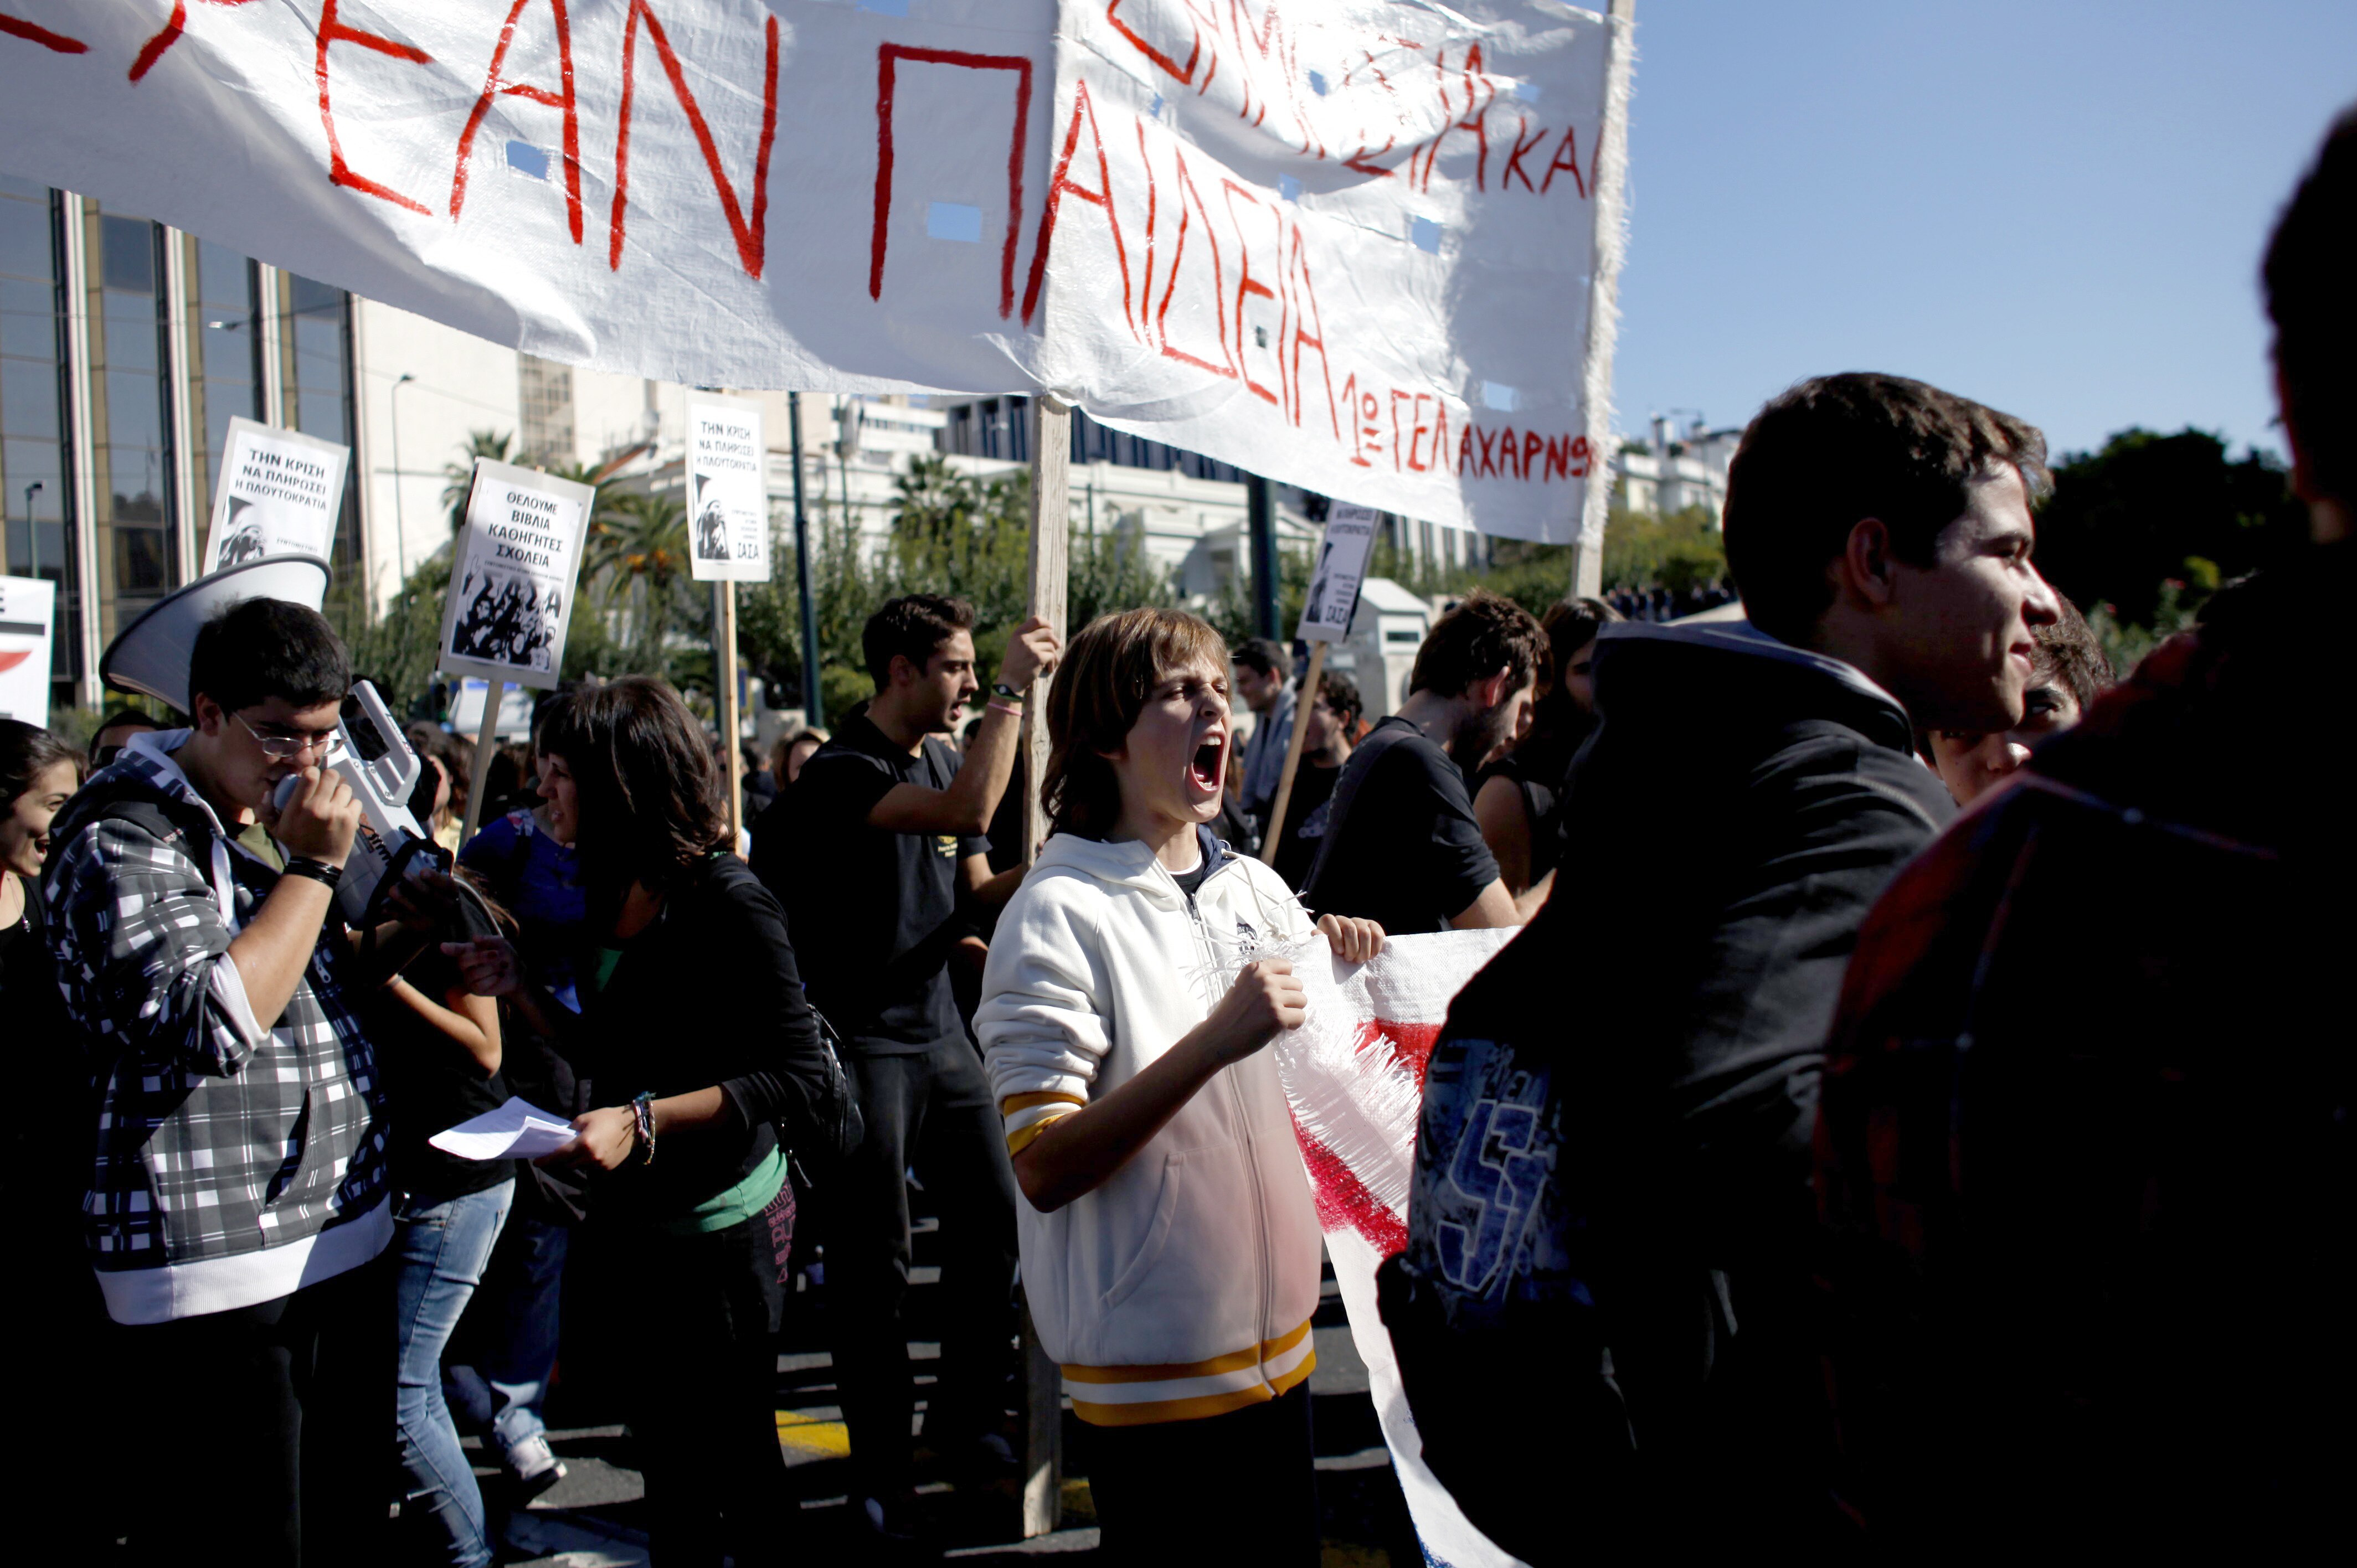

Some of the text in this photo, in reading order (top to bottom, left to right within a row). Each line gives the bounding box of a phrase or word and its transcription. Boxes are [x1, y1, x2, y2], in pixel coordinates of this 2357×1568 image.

[700, 421, 751, 441] ΤΗΝ ΚΡΙΣΗ
[699, 439, 712, 452] ΝΑ
[249, 448, 325, 479] ΤΗΝ ΚΡΙΣΗ
[242, 466, 326, 496] ΝΑ ΠΛΗΡΩΣΕΙ
[235, 479, 327, 510] Η ΠΛΟΥΤΟΚΡΑΤΙΑ
[507, 491, 558, 515] ΘΕΛΟΥΜΕ
[511, 509, 550, 530] ΒΙΒΛΙΑ
[488, 523, 563, 553] ΚΑΘΗΓΗΤΕΣ
[496, 544, 549, 568] ΣΧΟΛΕΙΑ
